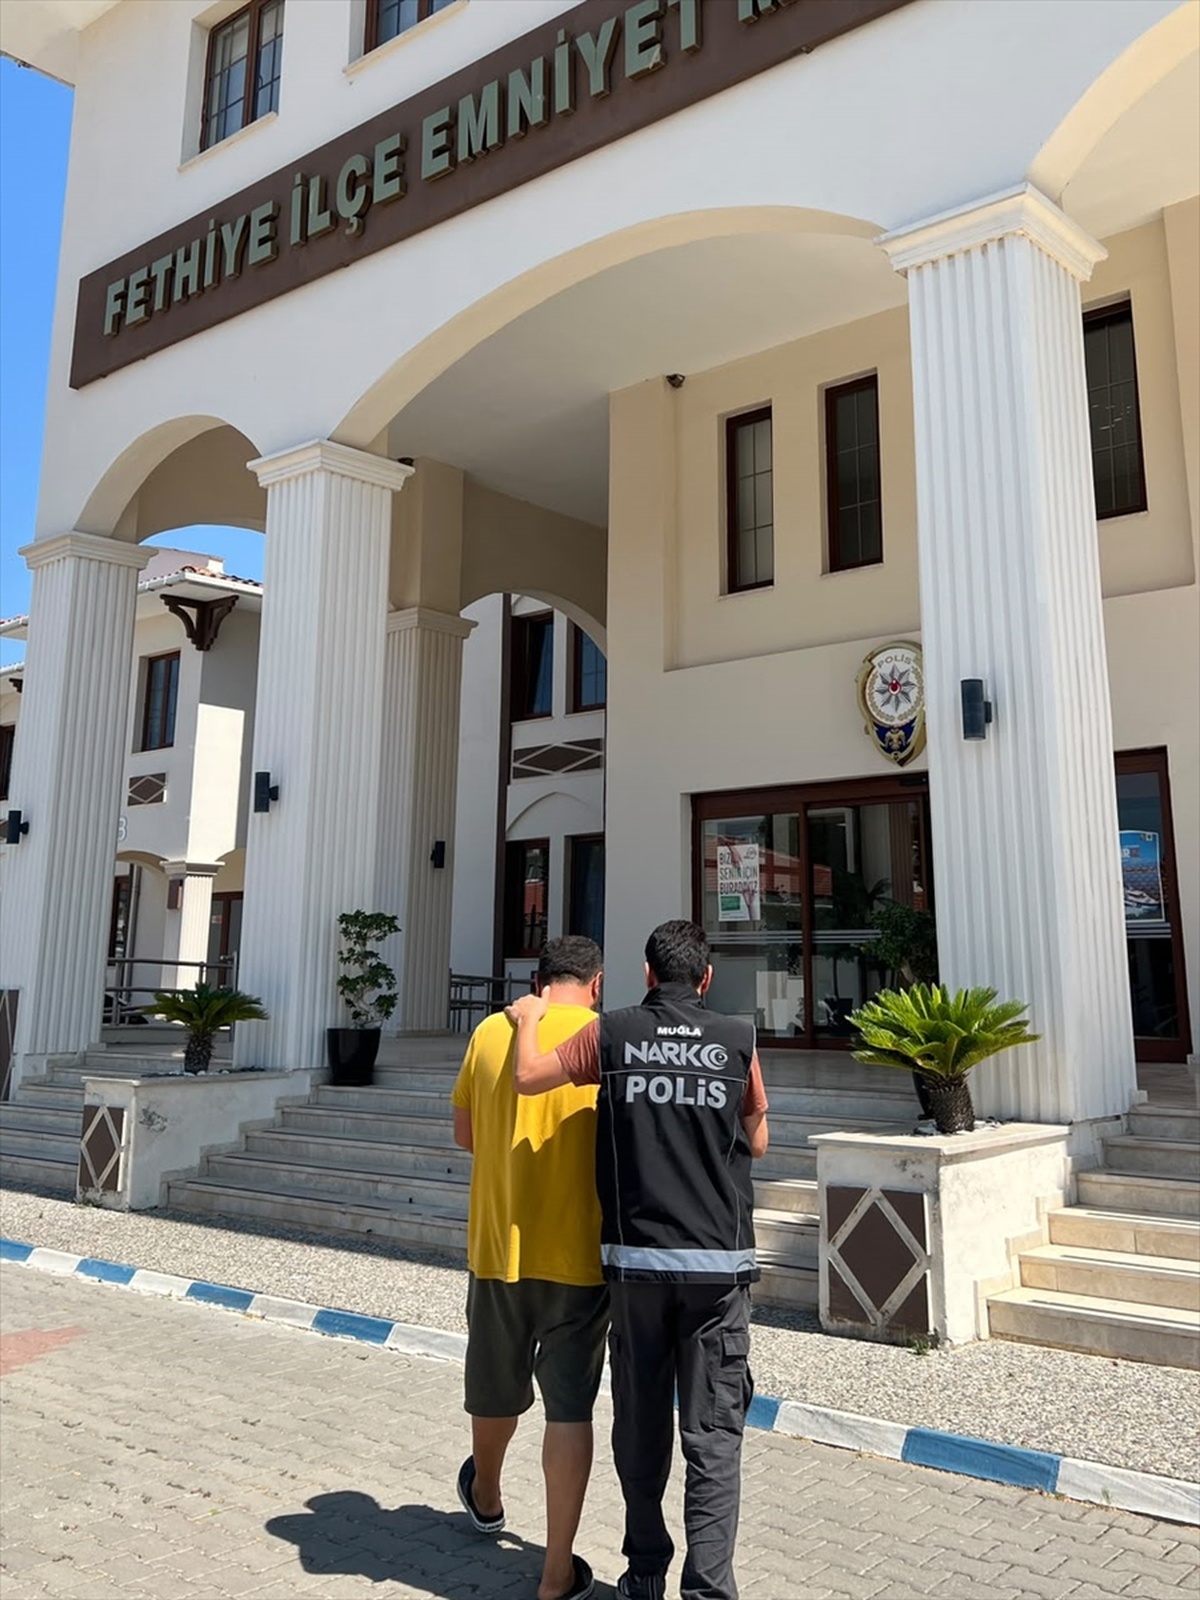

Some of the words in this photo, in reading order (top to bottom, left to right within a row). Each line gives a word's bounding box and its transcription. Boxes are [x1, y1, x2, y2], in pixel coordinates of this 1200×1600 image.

[104, 200, 277, 336] FETHİYE
[290, 132, 406, 247] İLÇE
[421, 0, 701, 182] EMNİYET
[656, 1025, 702, 1037] MUĞLA
